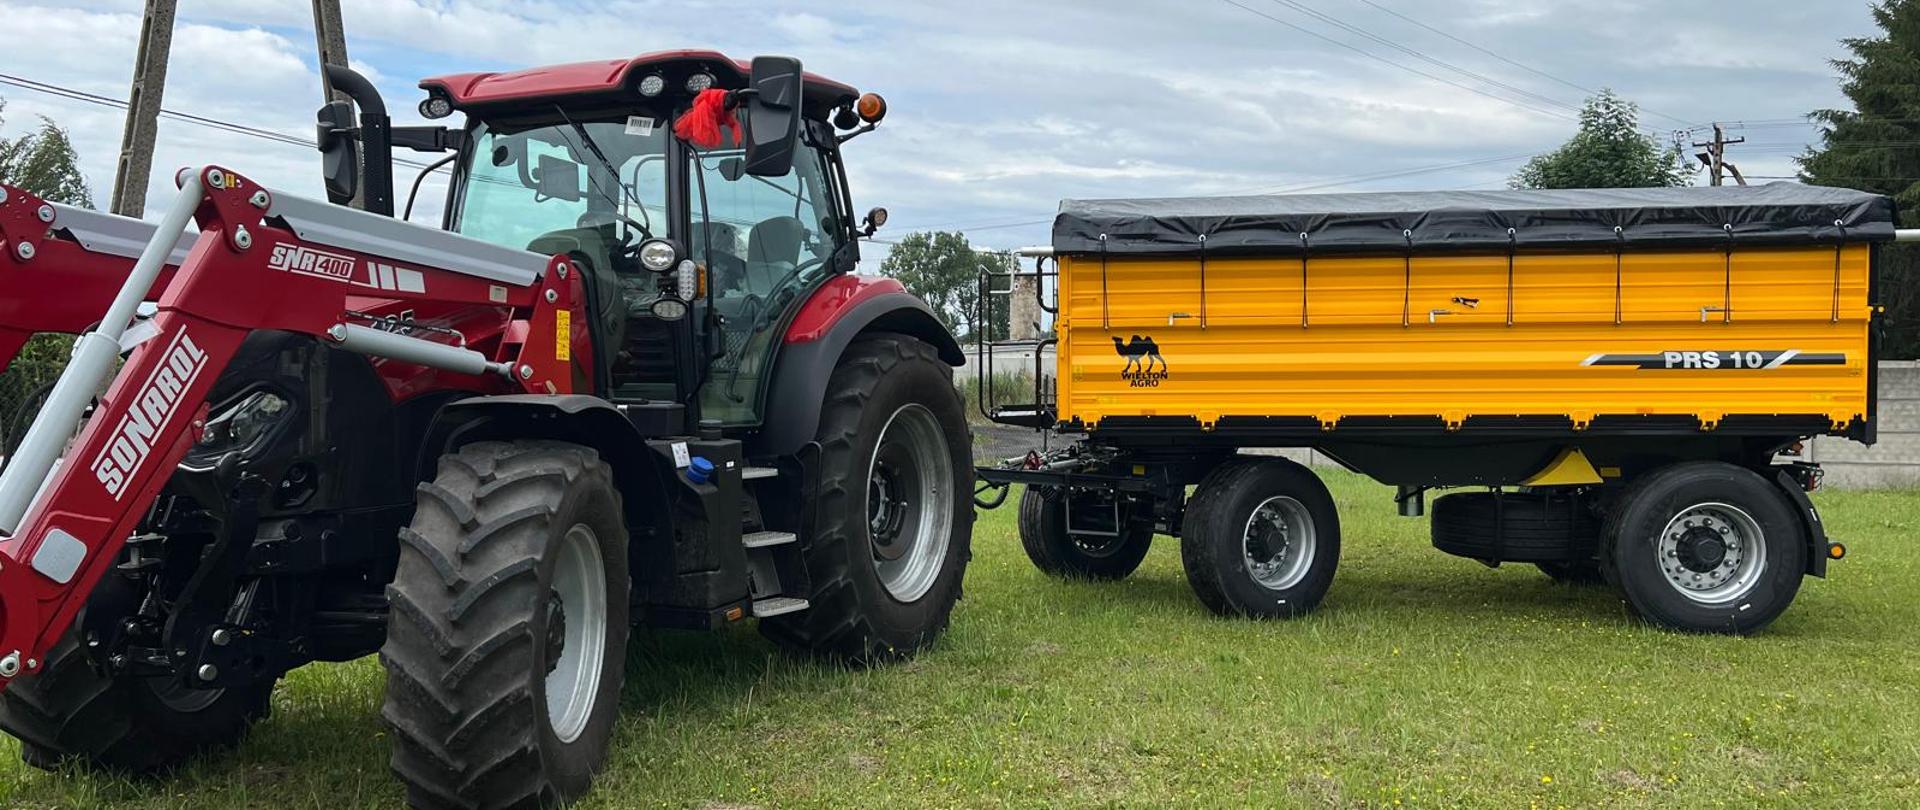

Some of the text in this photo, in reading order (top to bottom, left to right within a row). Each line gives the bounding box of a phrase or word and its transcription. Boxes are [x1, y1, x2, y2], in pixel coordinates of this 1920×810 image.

[1664, 351, 1763, 368] PRS 10
[1121, 371, 1168, 380] WIELTON
[1130, 380, 1159, 388] AGRO
[96, 334, 205, 495] SONAROL
